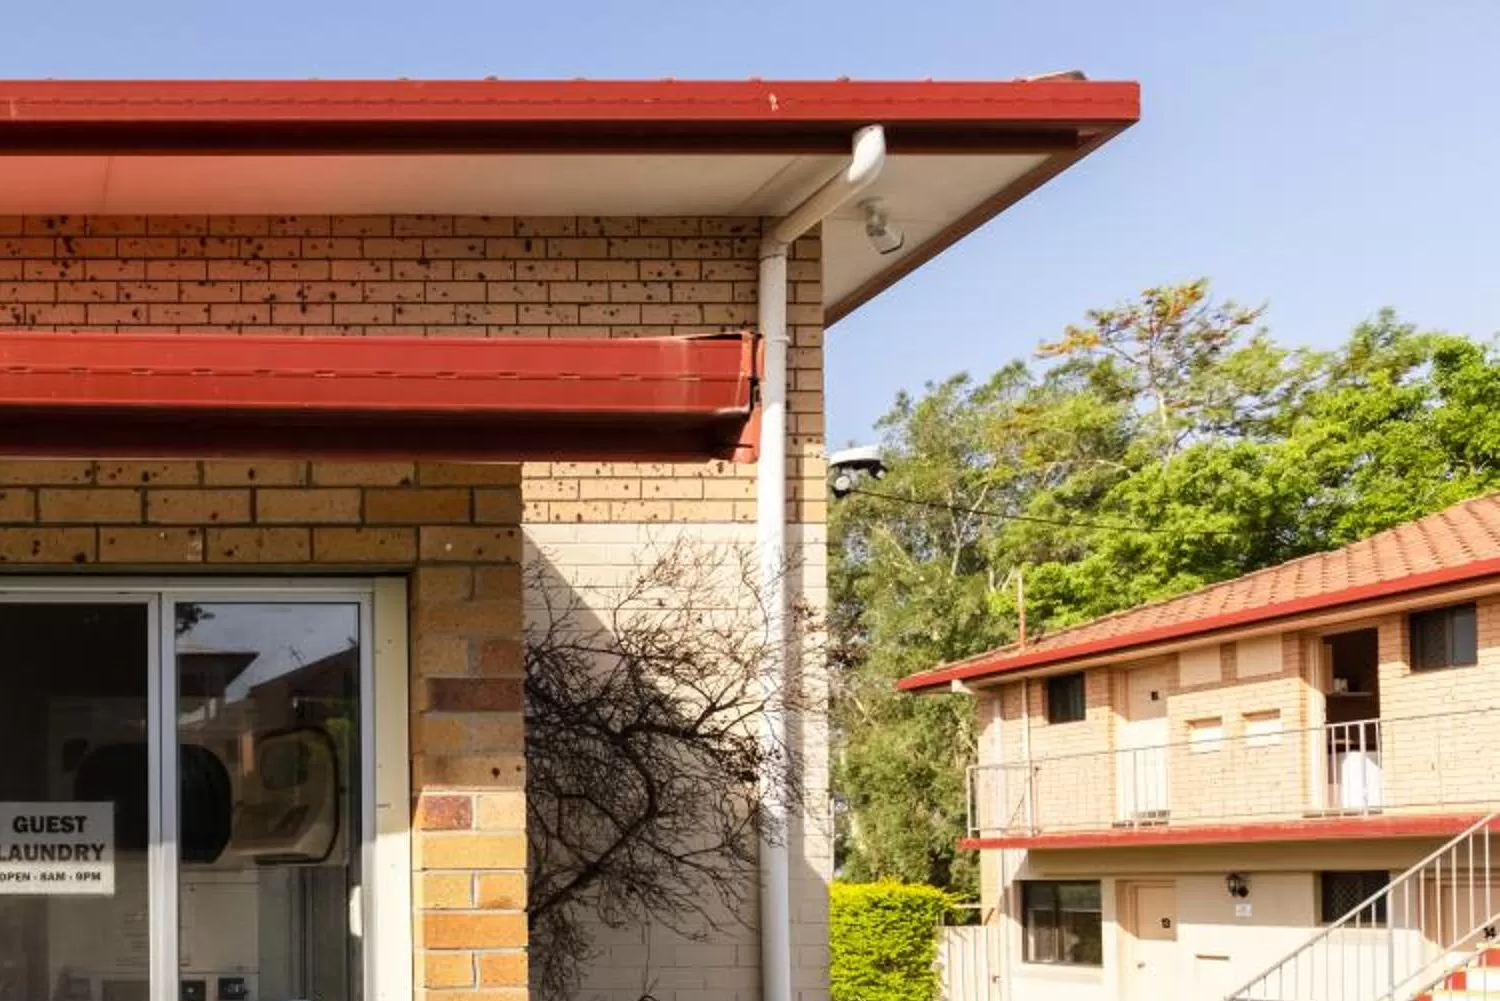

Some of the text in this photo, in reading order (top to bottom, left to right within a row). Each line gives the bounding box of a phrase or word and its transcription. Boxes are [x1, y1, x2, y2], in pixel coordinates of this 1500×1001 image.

[12, 815, 87, 833] GUEST
[39, 871, 66, 882] 8AM
[75, 871, 101, 882] 9PM
